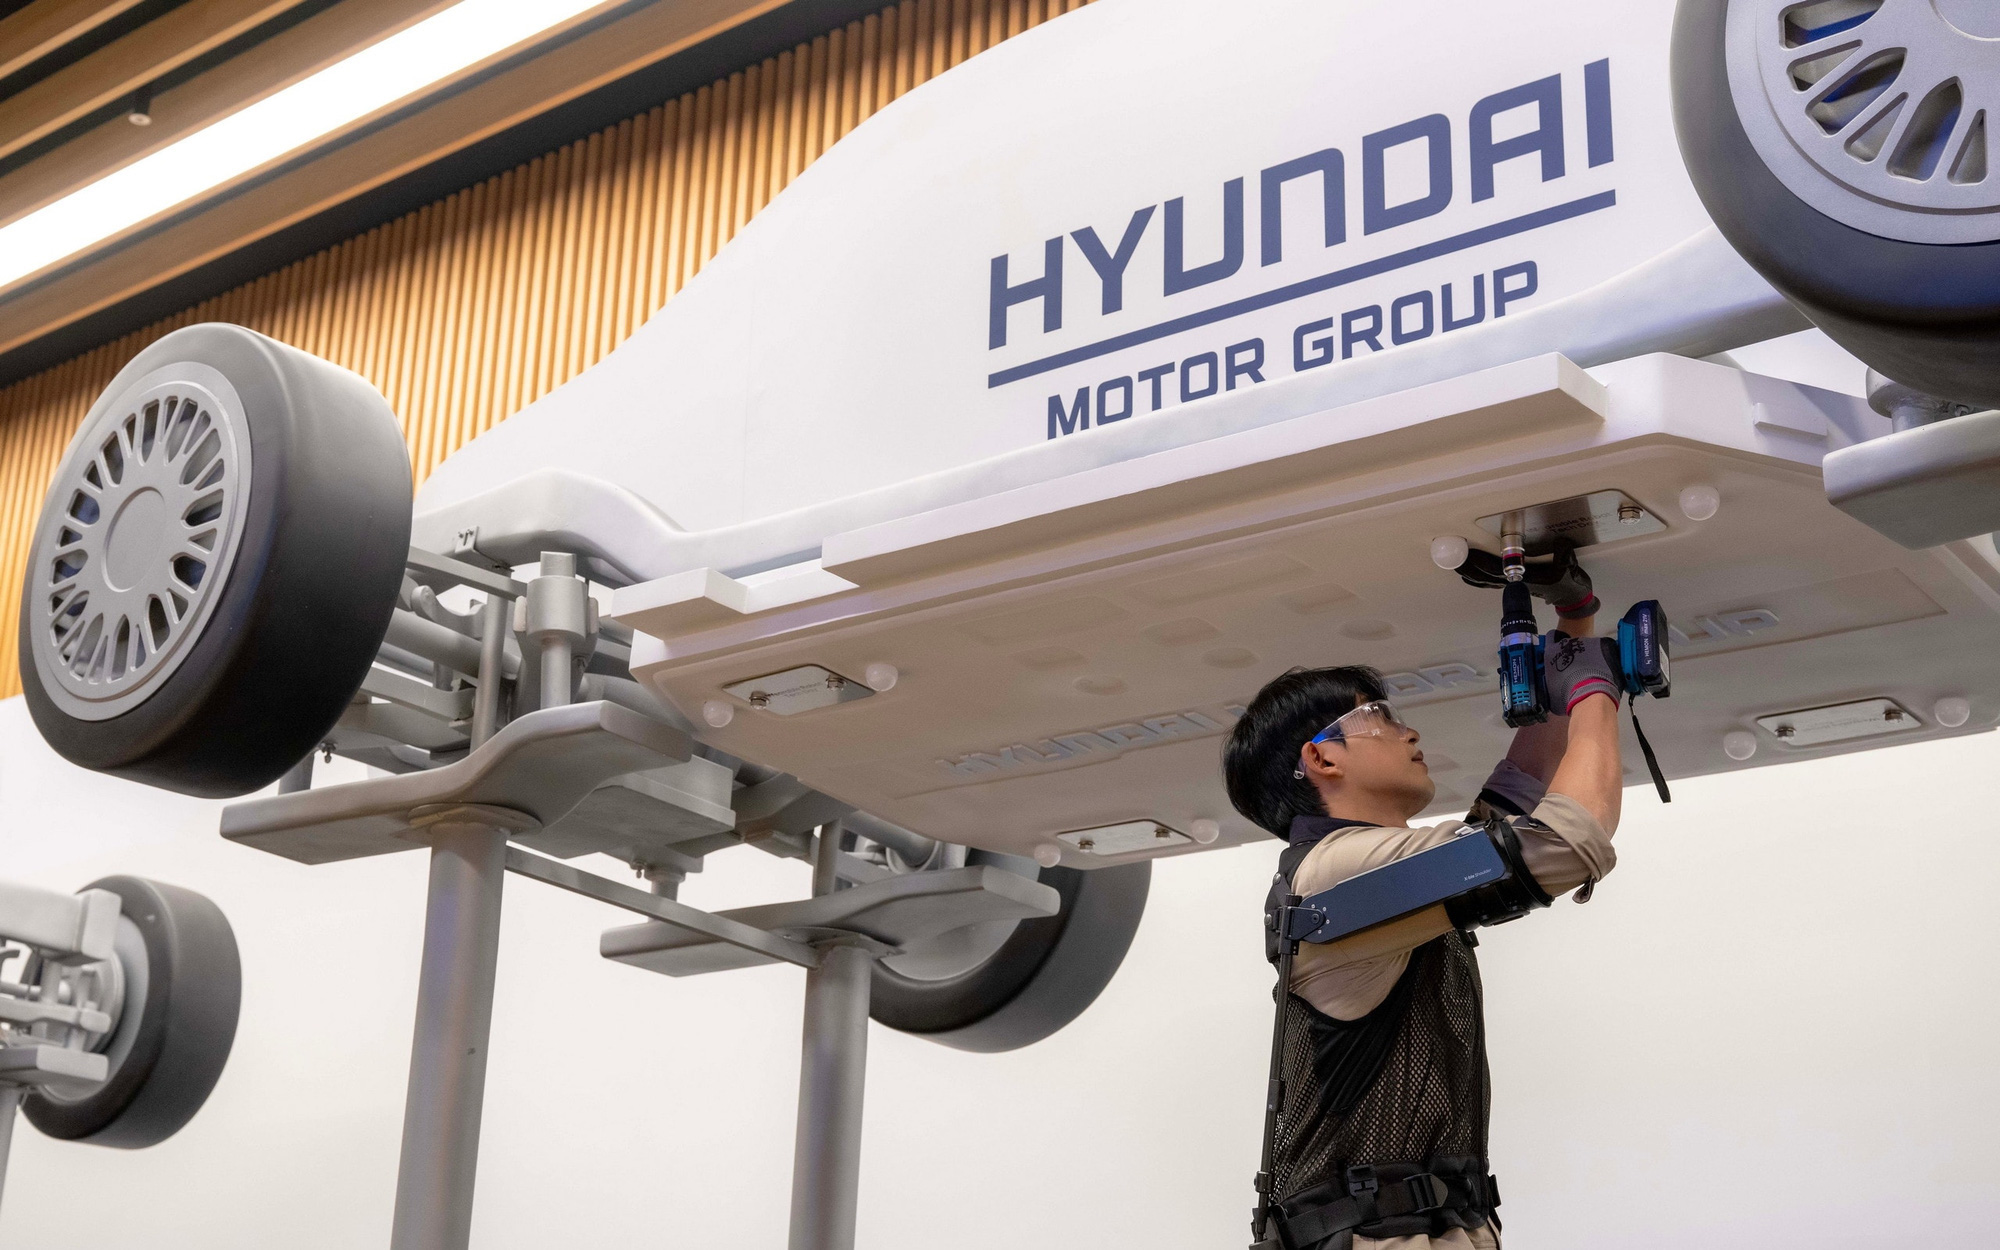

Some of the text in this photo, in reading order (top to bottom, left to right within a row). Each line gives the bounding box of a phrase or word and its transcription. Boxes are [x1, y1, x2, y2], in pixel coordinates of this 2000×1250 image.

[988, 57, 1614, 351] HYUNDAI
[1047, 260, 1538, 440] MOTOR GROUP
[935, 711, 1223, 776] HYUNDAI
